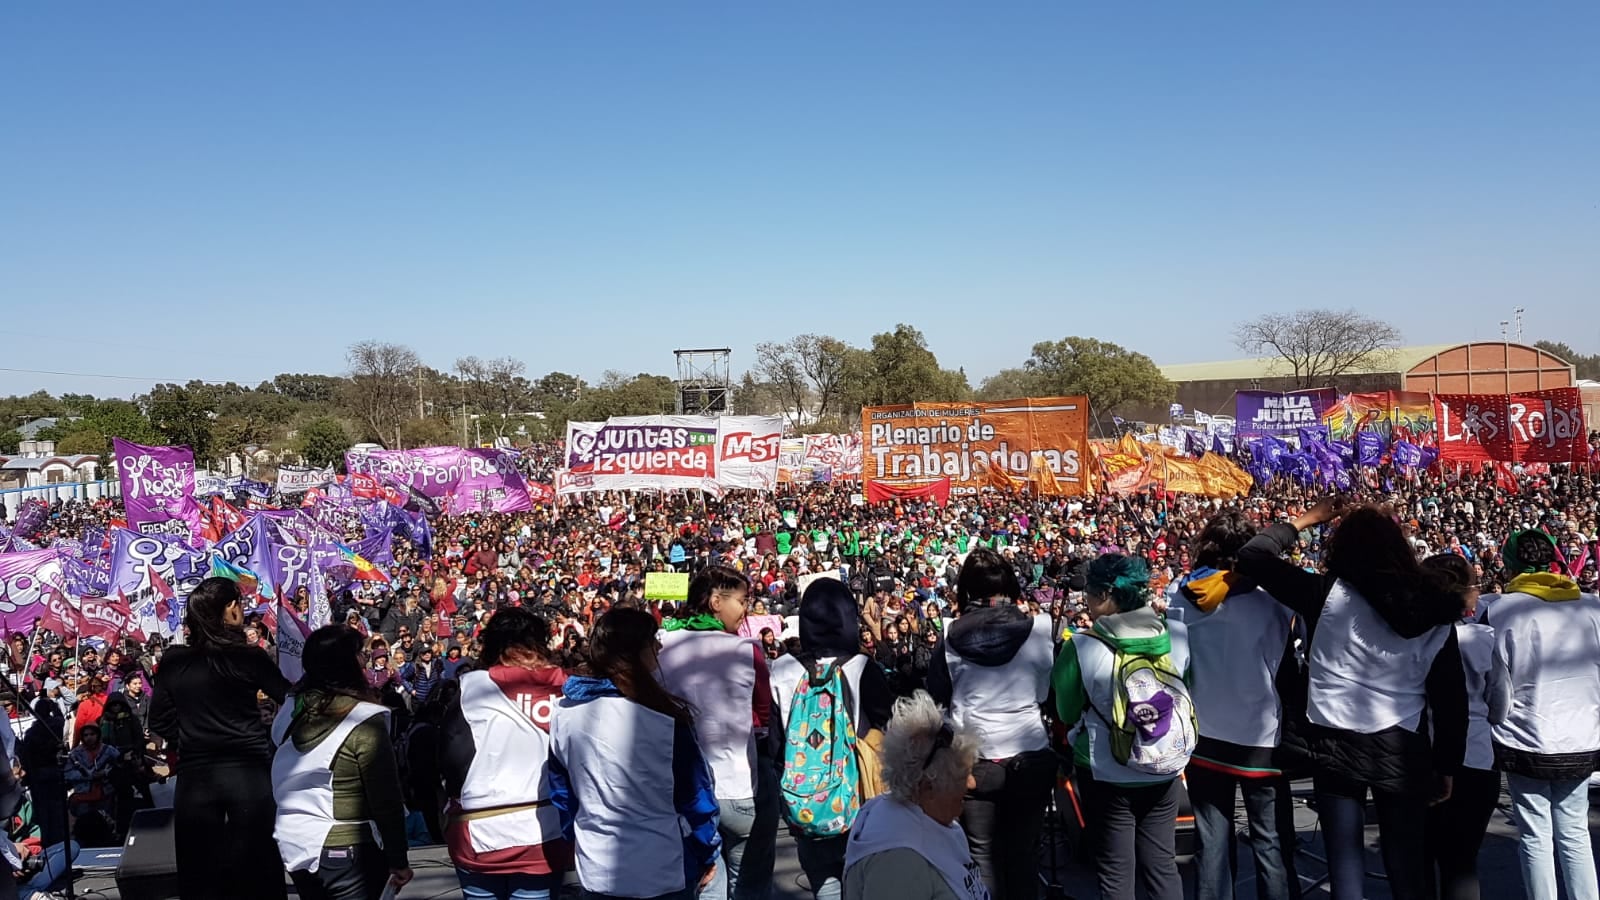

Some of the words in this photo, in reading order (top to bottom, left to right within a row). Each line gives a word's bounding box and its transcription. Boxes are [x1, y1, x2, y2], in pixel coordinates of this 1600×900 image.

[1264, 396, 1311, 408] MALA
[929, 410, 940, 418] DE
[943, 409, 980, 417] MUJERES
[1252, 408, 1316, 422] JUNTA
[871, 421, 961, 446] Plenario
[968, 419, 994, 441] de
[1252, 422, 1275, 430] Poder
[727, 437, 779, 461] MST
[594, 448, 707, 473] izquierda
